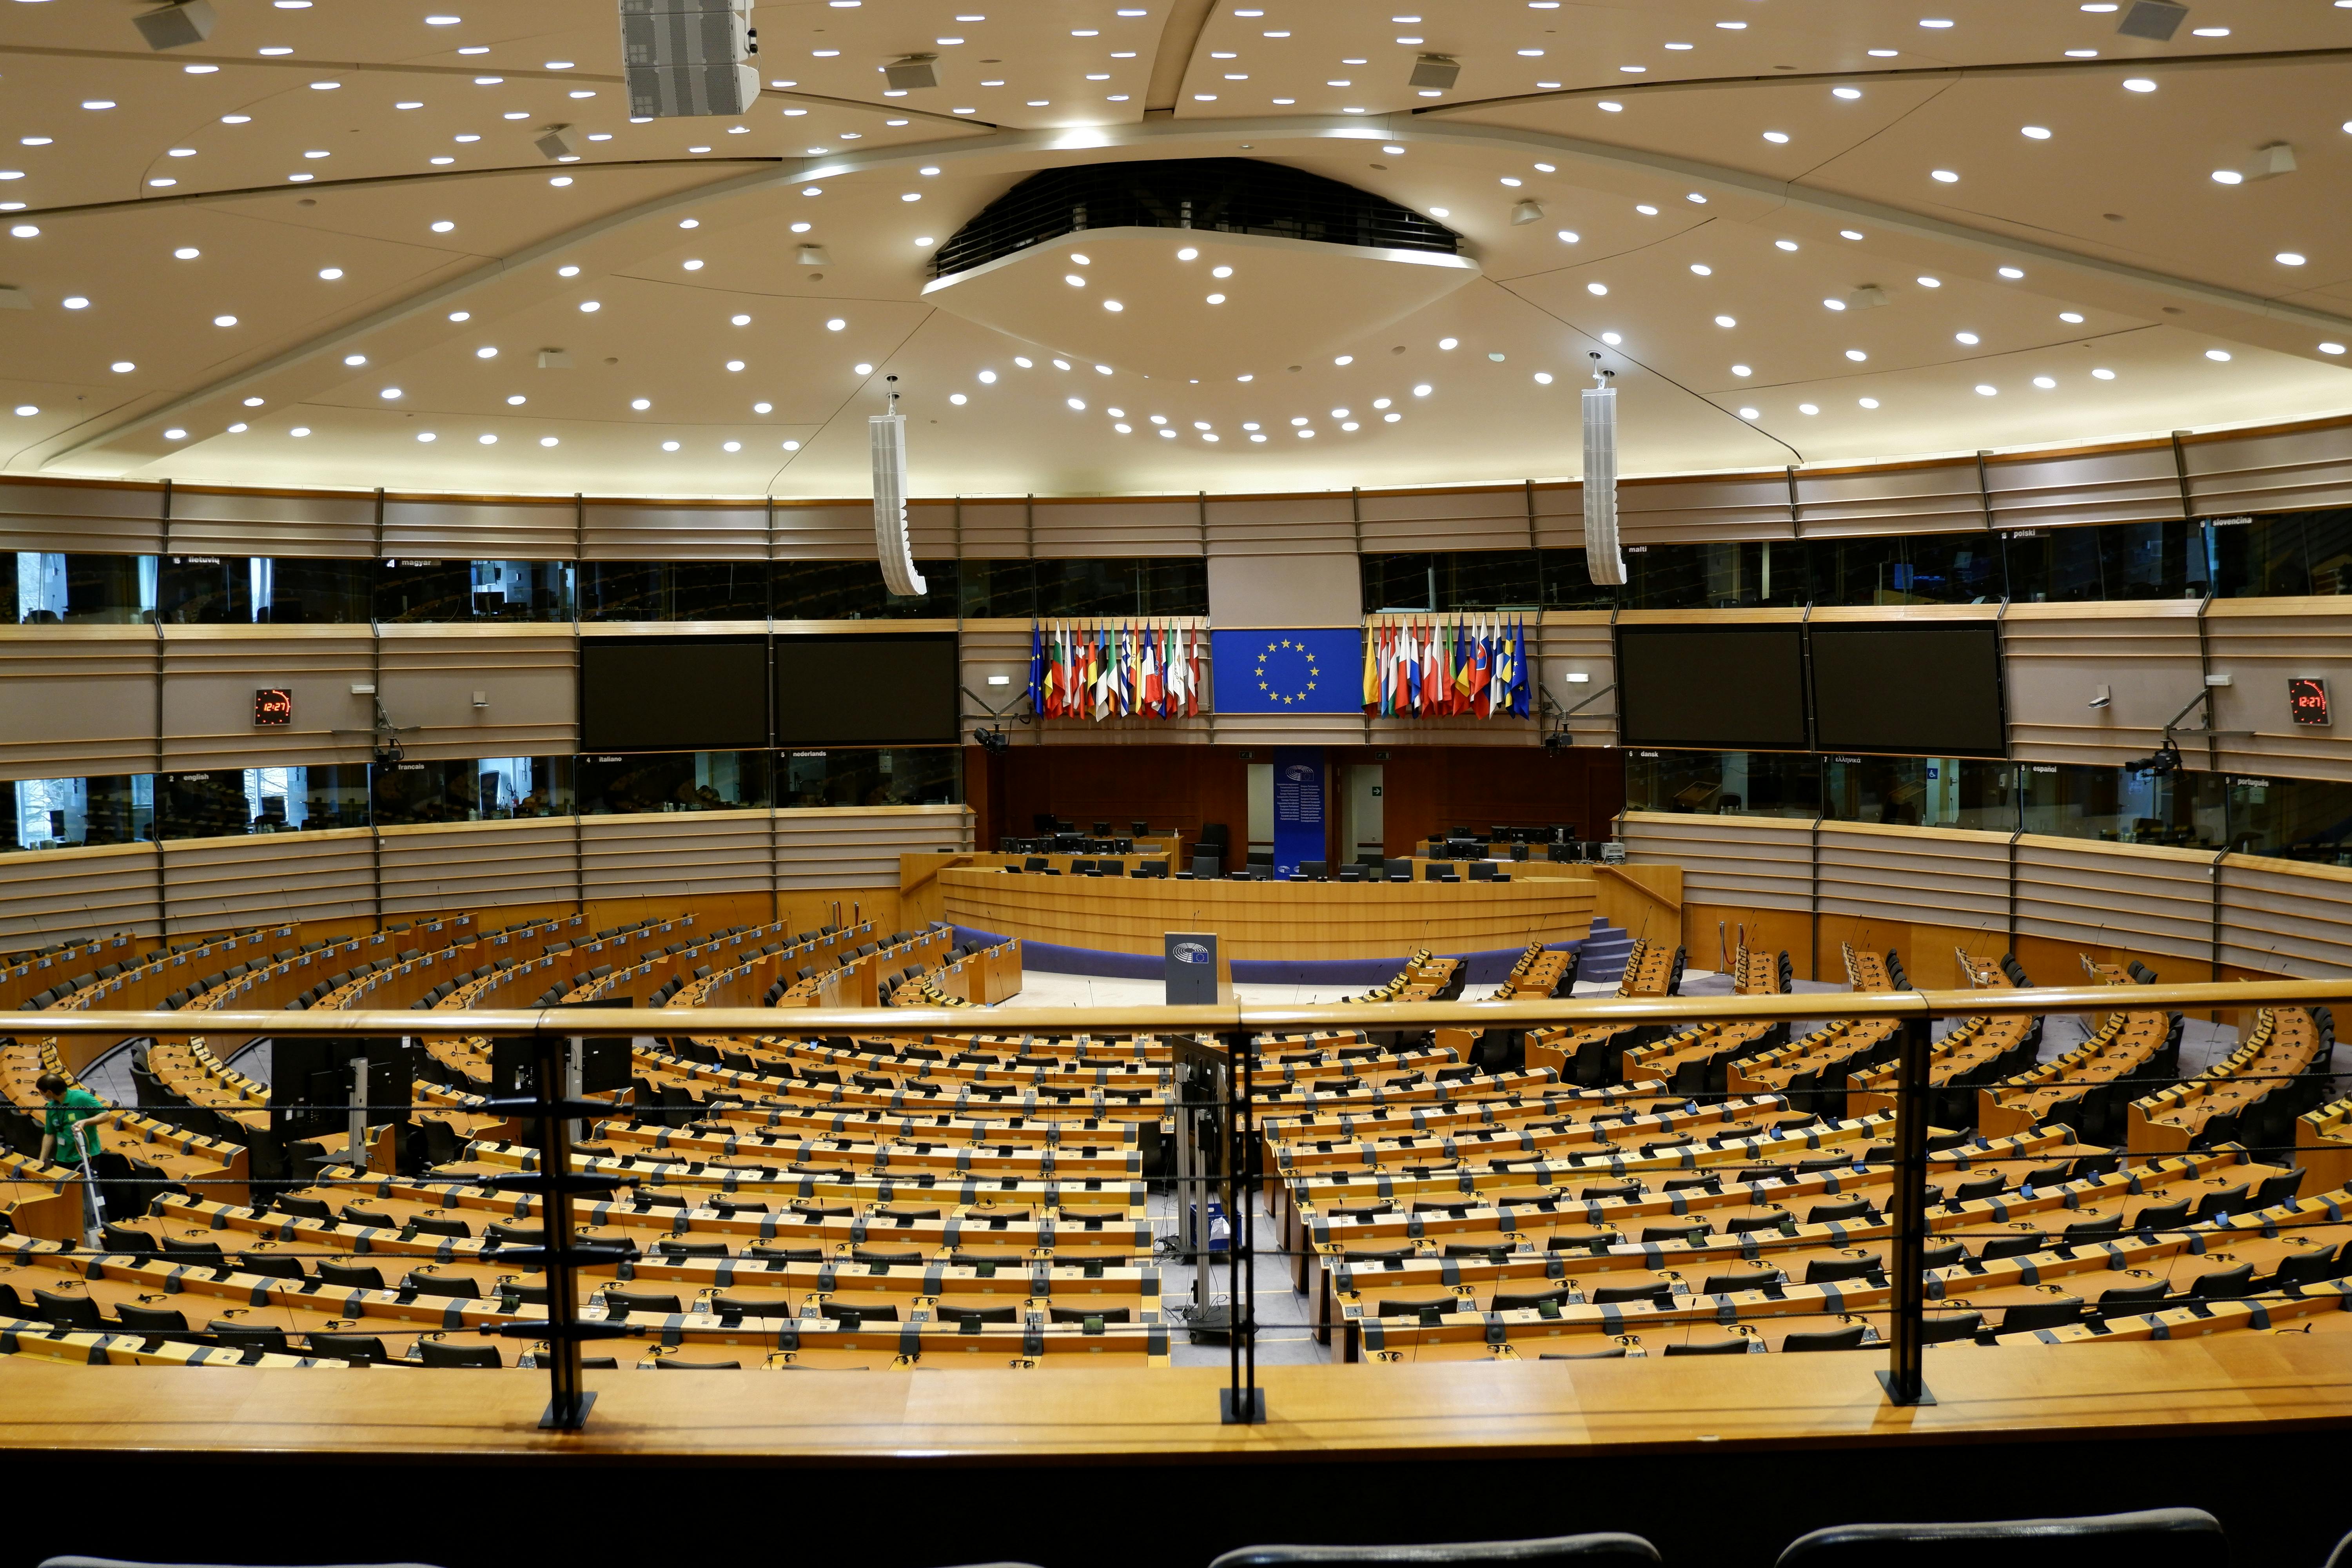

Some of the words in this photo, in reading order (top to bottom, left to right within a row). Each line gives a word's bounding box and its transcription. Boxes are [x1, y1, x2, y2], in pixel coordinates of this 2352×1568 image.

[2213, 516, 2252, 526] slovenčina
[2213, 516, 2252, 526] slovenčina
[2014, 529, 2035, 538] polski
[2299, 697, 2320, 707] 12:27
[264, 703, 285, 711] 12:27
[2238, 778, 2269, 787] português
